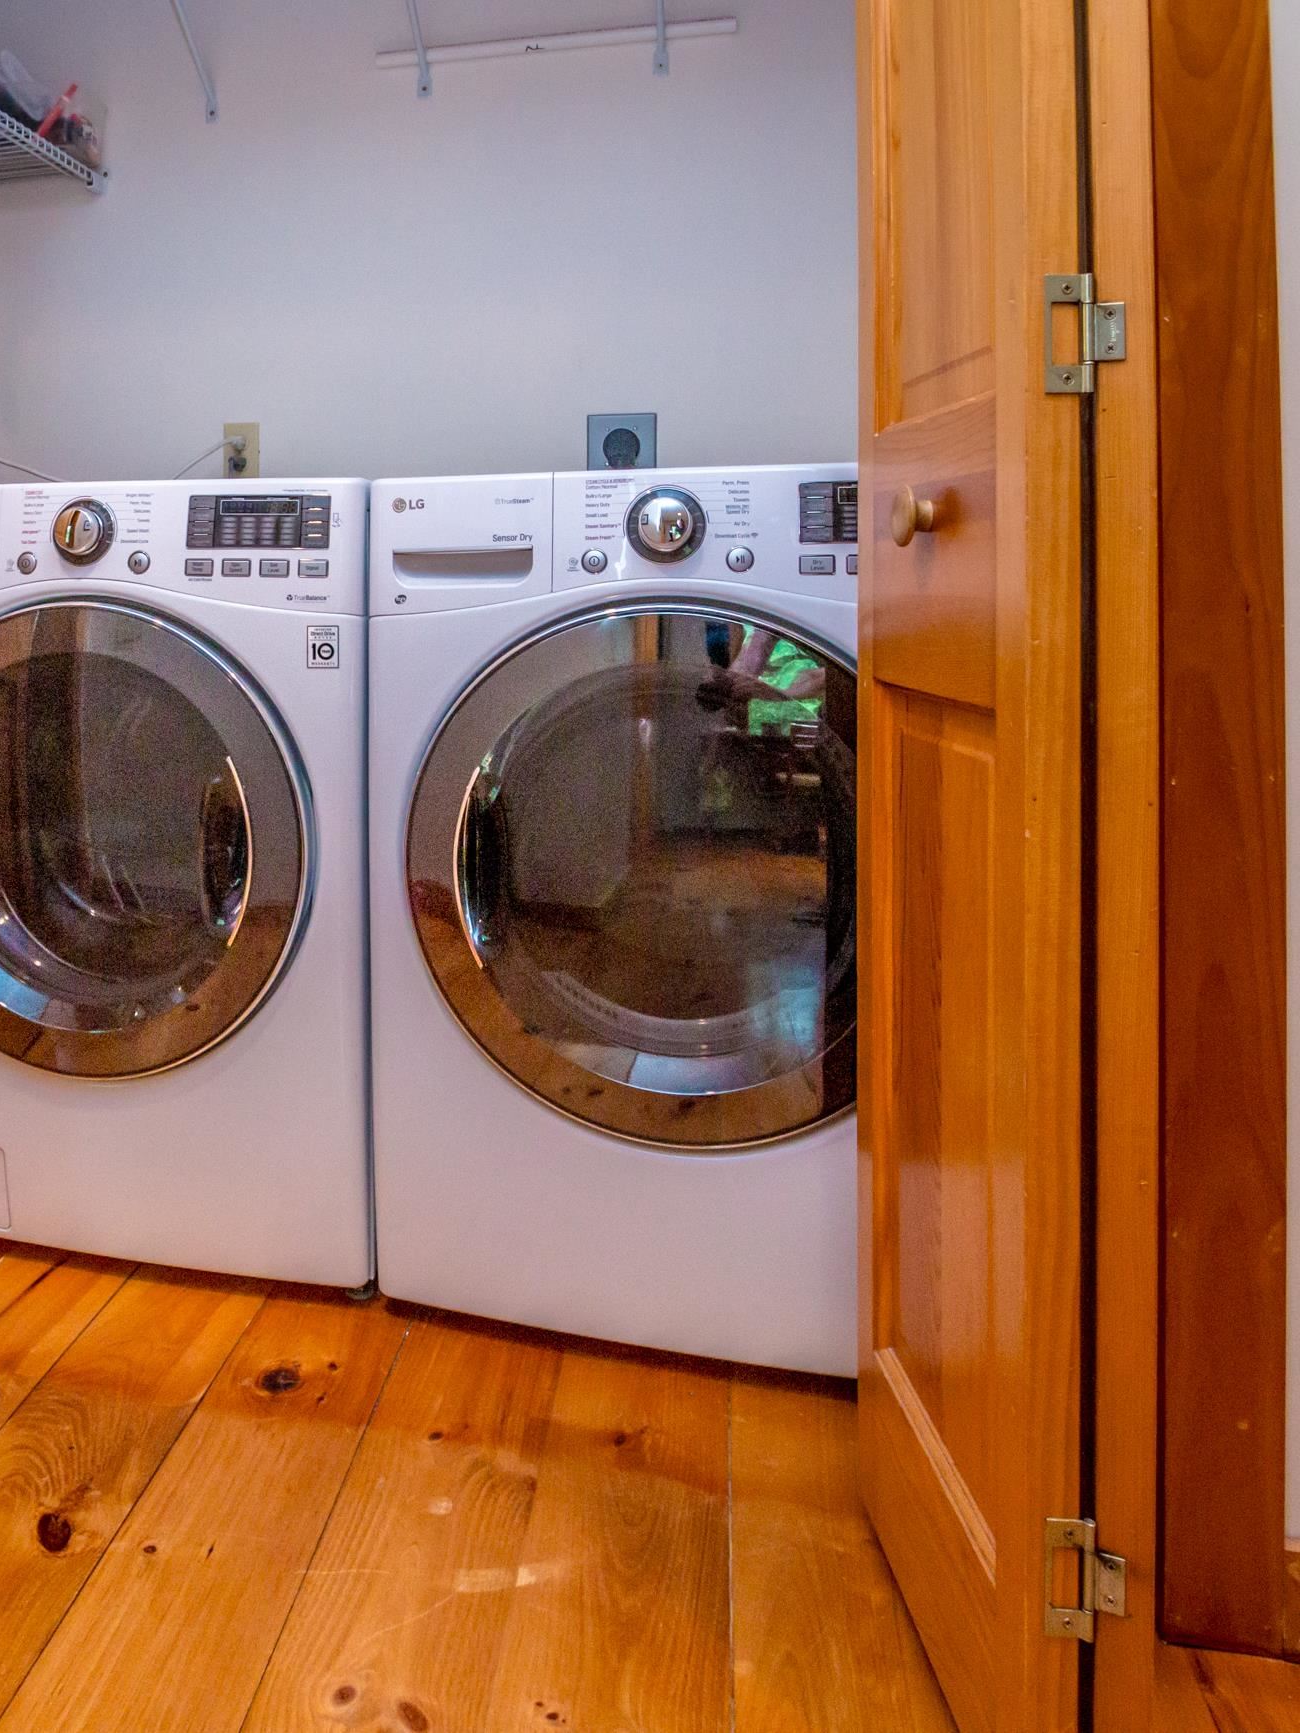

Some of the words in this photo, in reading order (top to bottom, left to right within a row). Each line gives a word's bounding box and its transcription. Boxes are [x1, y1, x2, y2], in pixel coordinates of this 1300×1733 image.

[409, 499, 425, 510] LG
[492, 534, 518, 542] Sensor
[519, 533, 533, 542] Dry
[311, 642, 335, 660] 10
